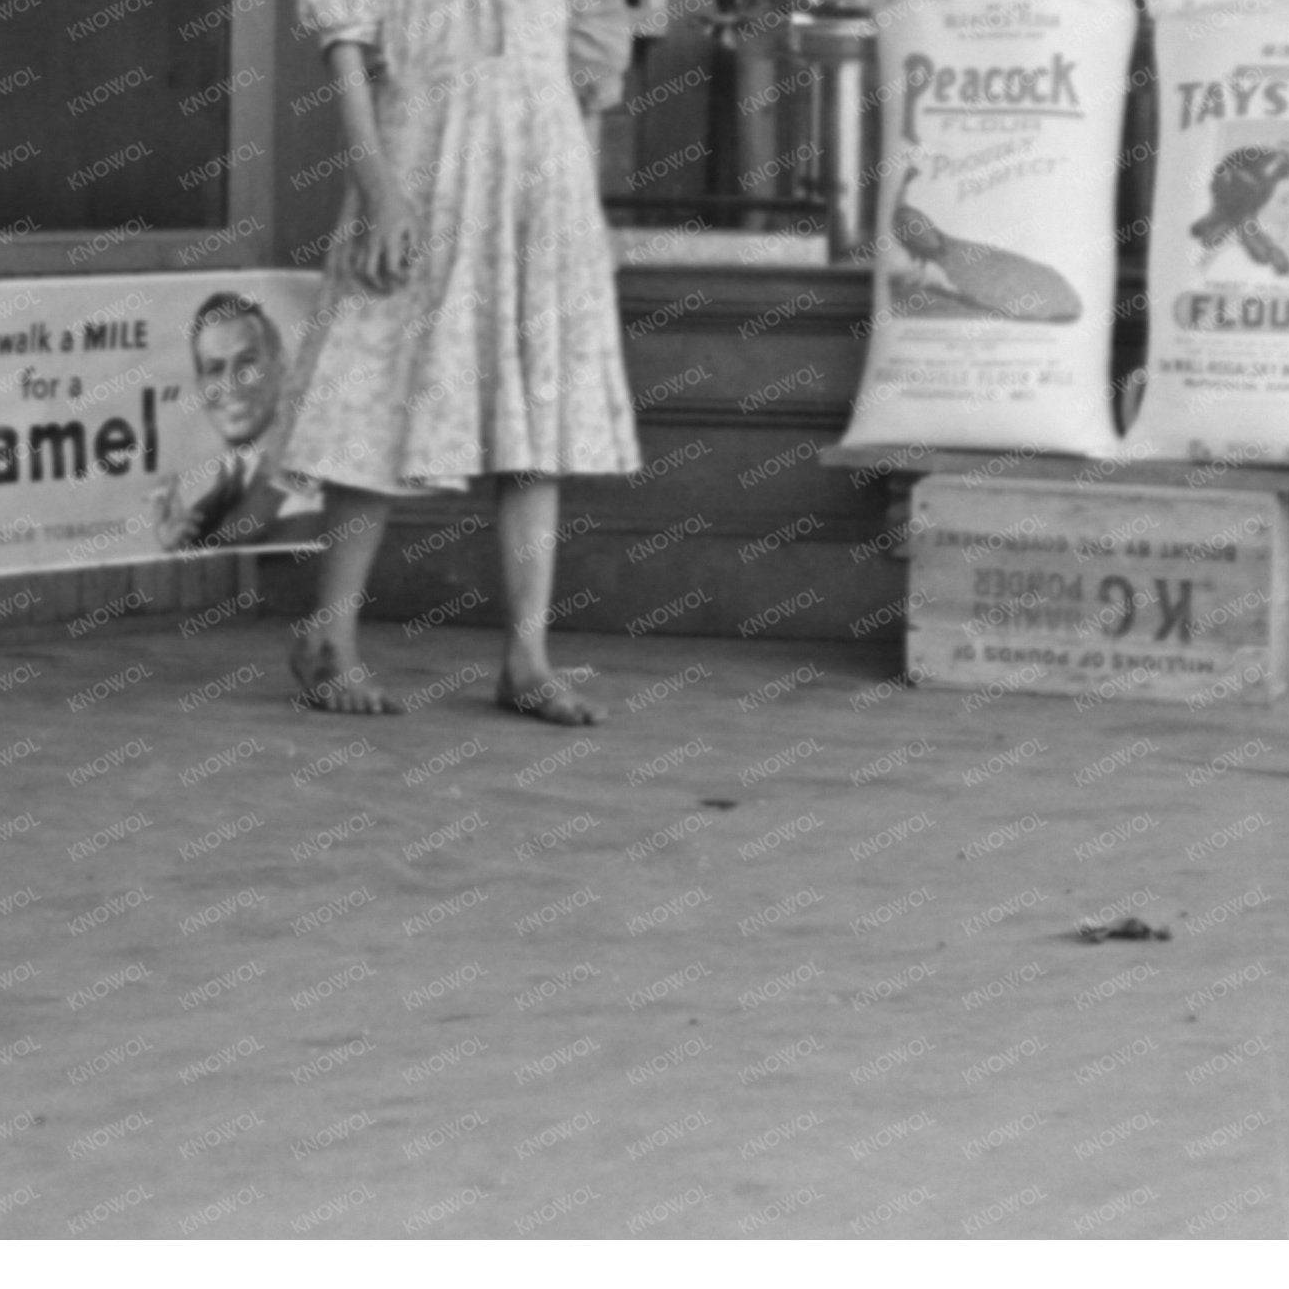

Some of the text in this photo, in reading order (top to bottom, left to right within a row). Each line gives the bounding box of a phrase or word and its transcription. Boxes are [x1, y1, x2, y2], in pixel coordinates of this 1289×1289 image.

[901, 49, 1081, 147] Peacock
[59, 327, 77, 356] a
[82, 317, 149, 352] MILE
[19, 364, 86, 401] for a
[972, 568, 1084, 602] POWDER
[983, 646, 1071, 667] POUNDS
[1077, 651, 1106, 670] OF
